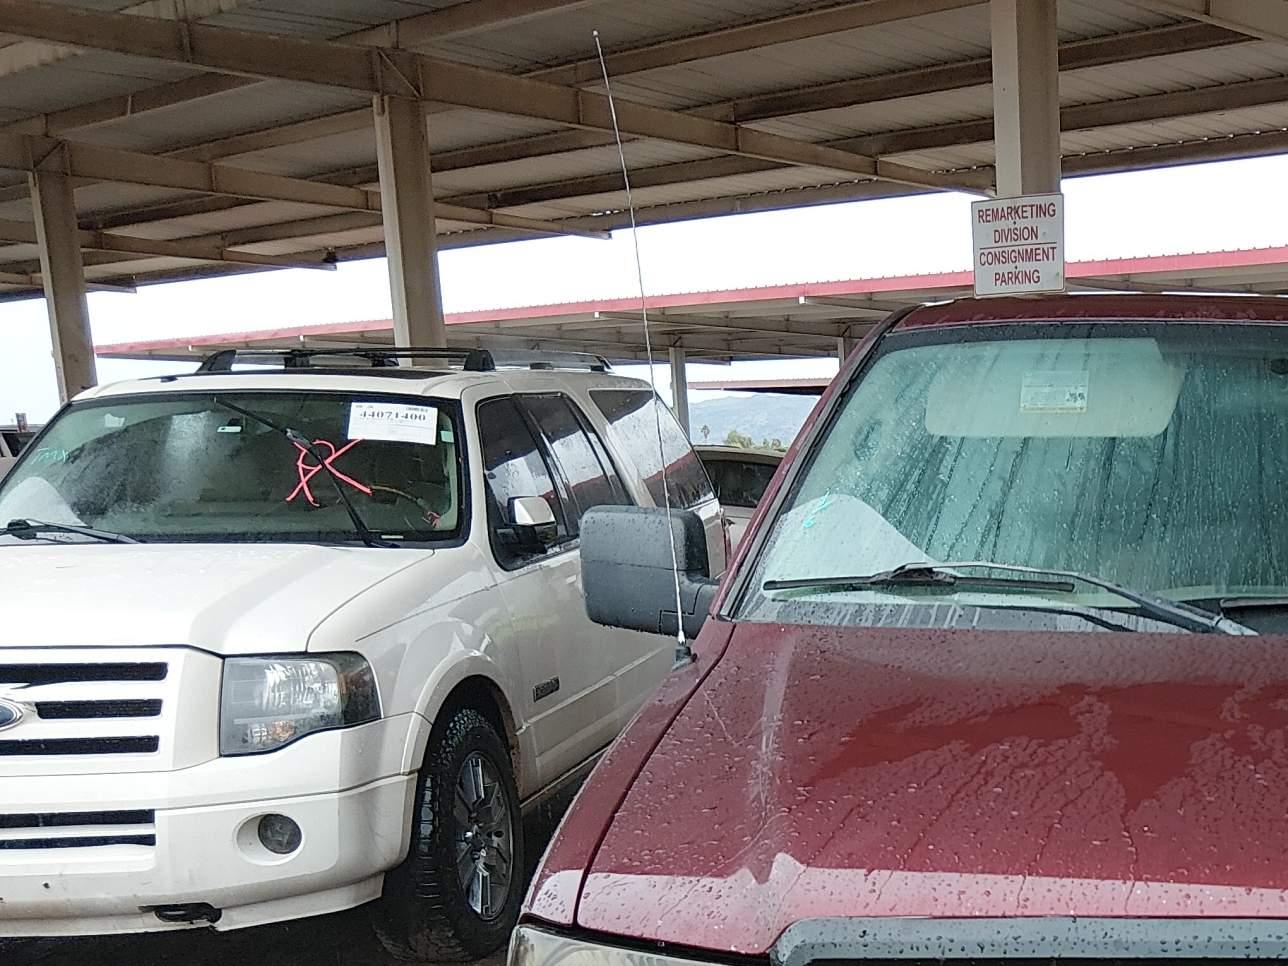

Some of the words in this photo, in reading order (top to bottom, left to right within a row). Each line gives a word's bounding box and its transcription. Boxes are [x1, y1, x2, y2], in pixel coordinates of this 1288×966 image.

[977, 202, 1056, 223] REMARKETING
[993, 226, 1039, 244] DIVISION
[979, 246, 1057, 266] CONSIGNMENT
[994, 269, 1041, 287] PARKING
